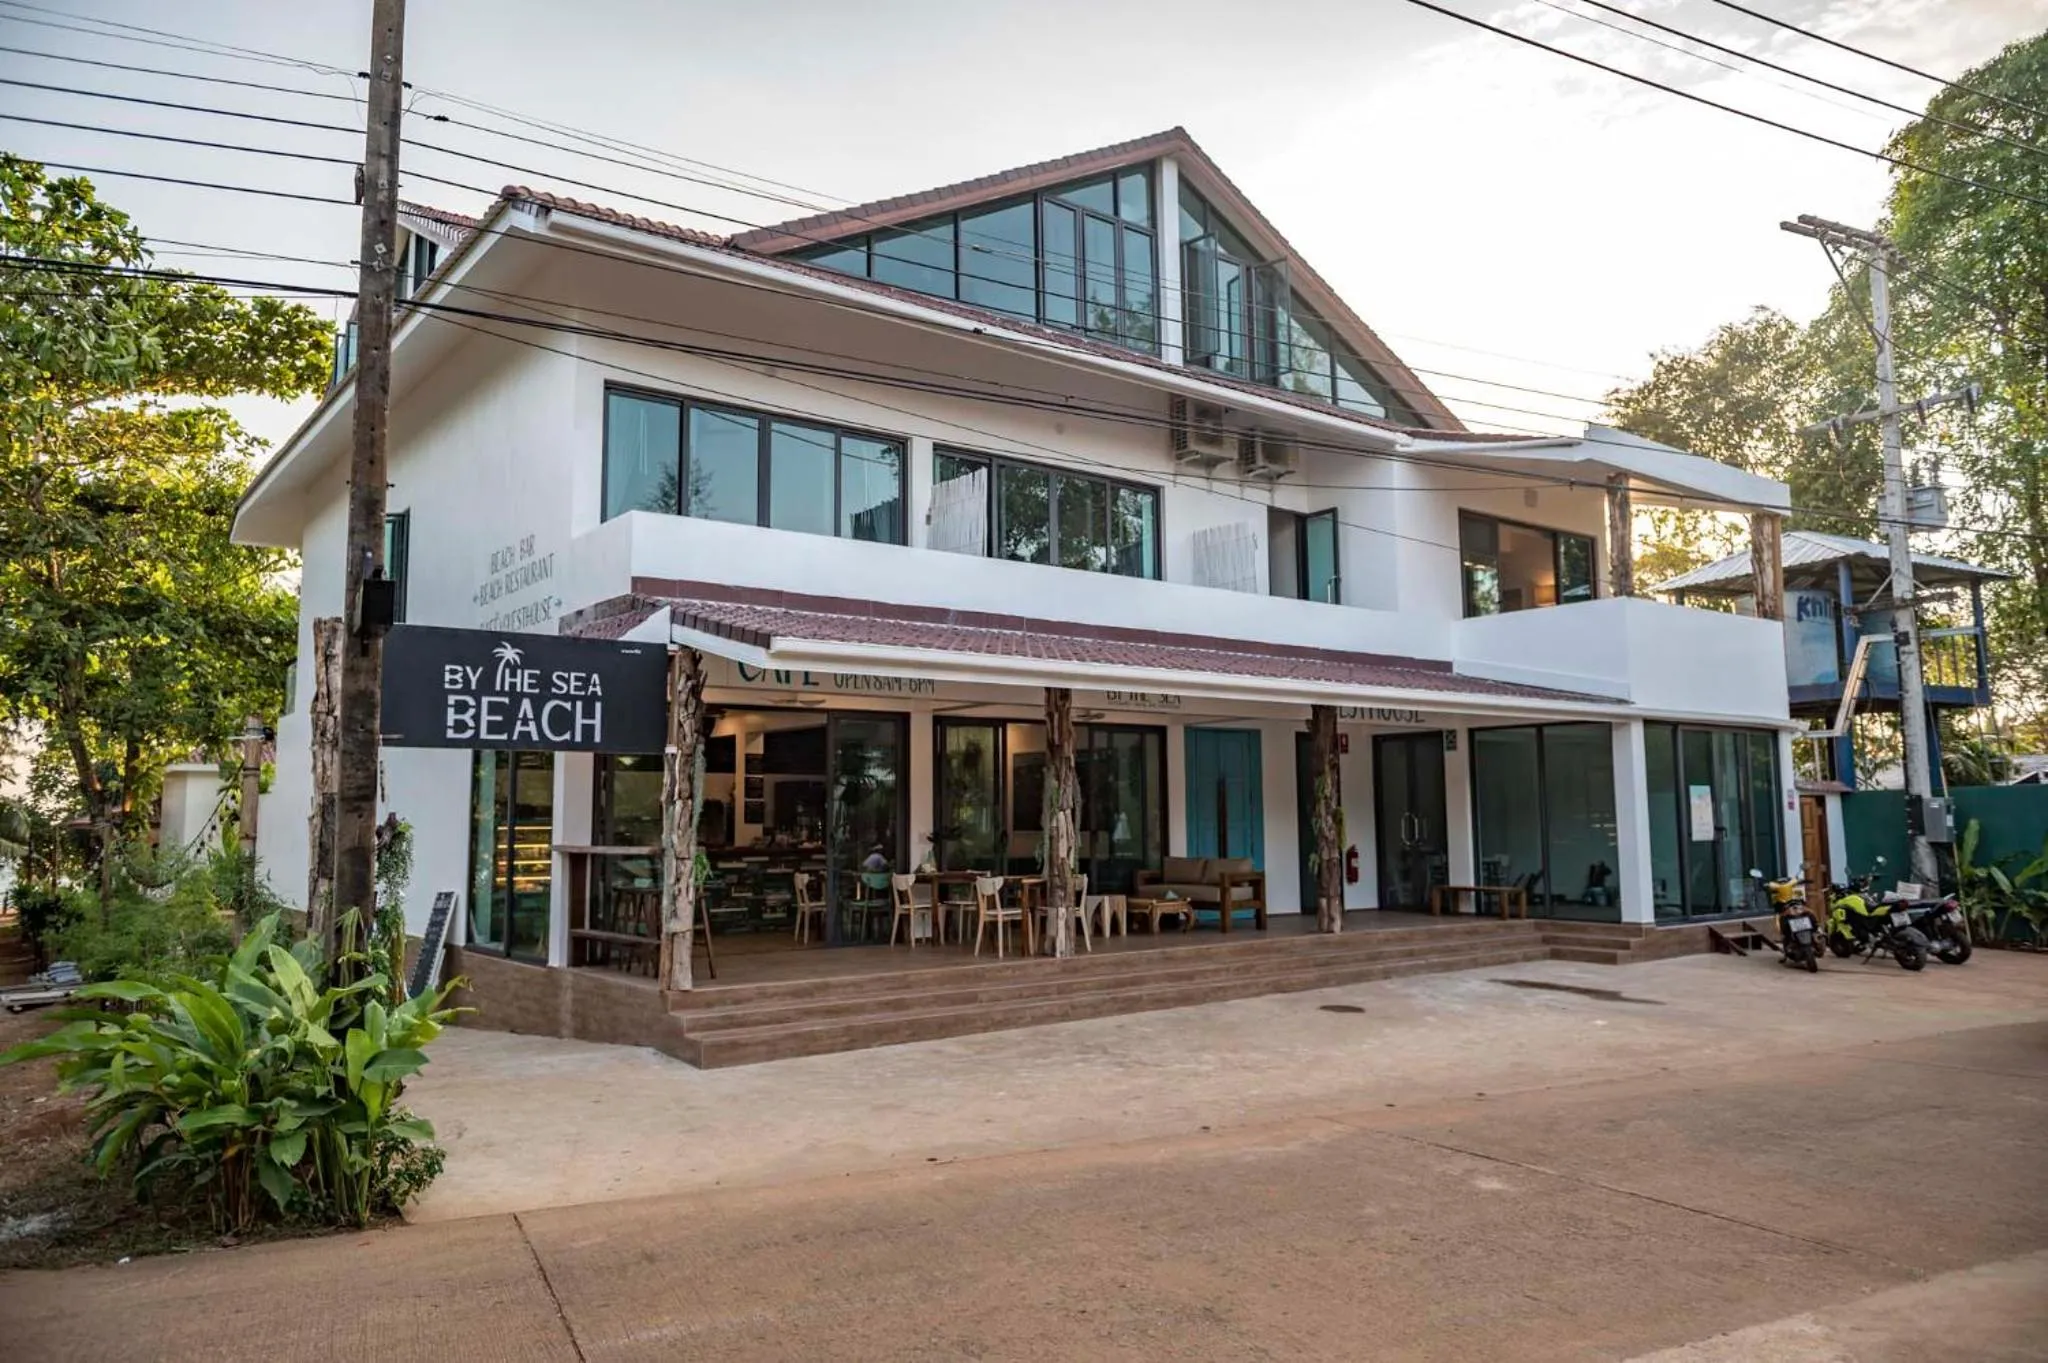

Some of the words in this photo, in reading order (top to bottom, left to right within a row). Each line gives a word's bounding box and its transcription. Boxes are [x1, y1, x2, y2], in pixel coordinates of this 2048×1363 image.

[505, 552, 554, 594] RESTAURANT
[445, 664, 483, 691] BY
[551, 671, 602, 696] SEA
[445, 695, 602, 743] BEACH
